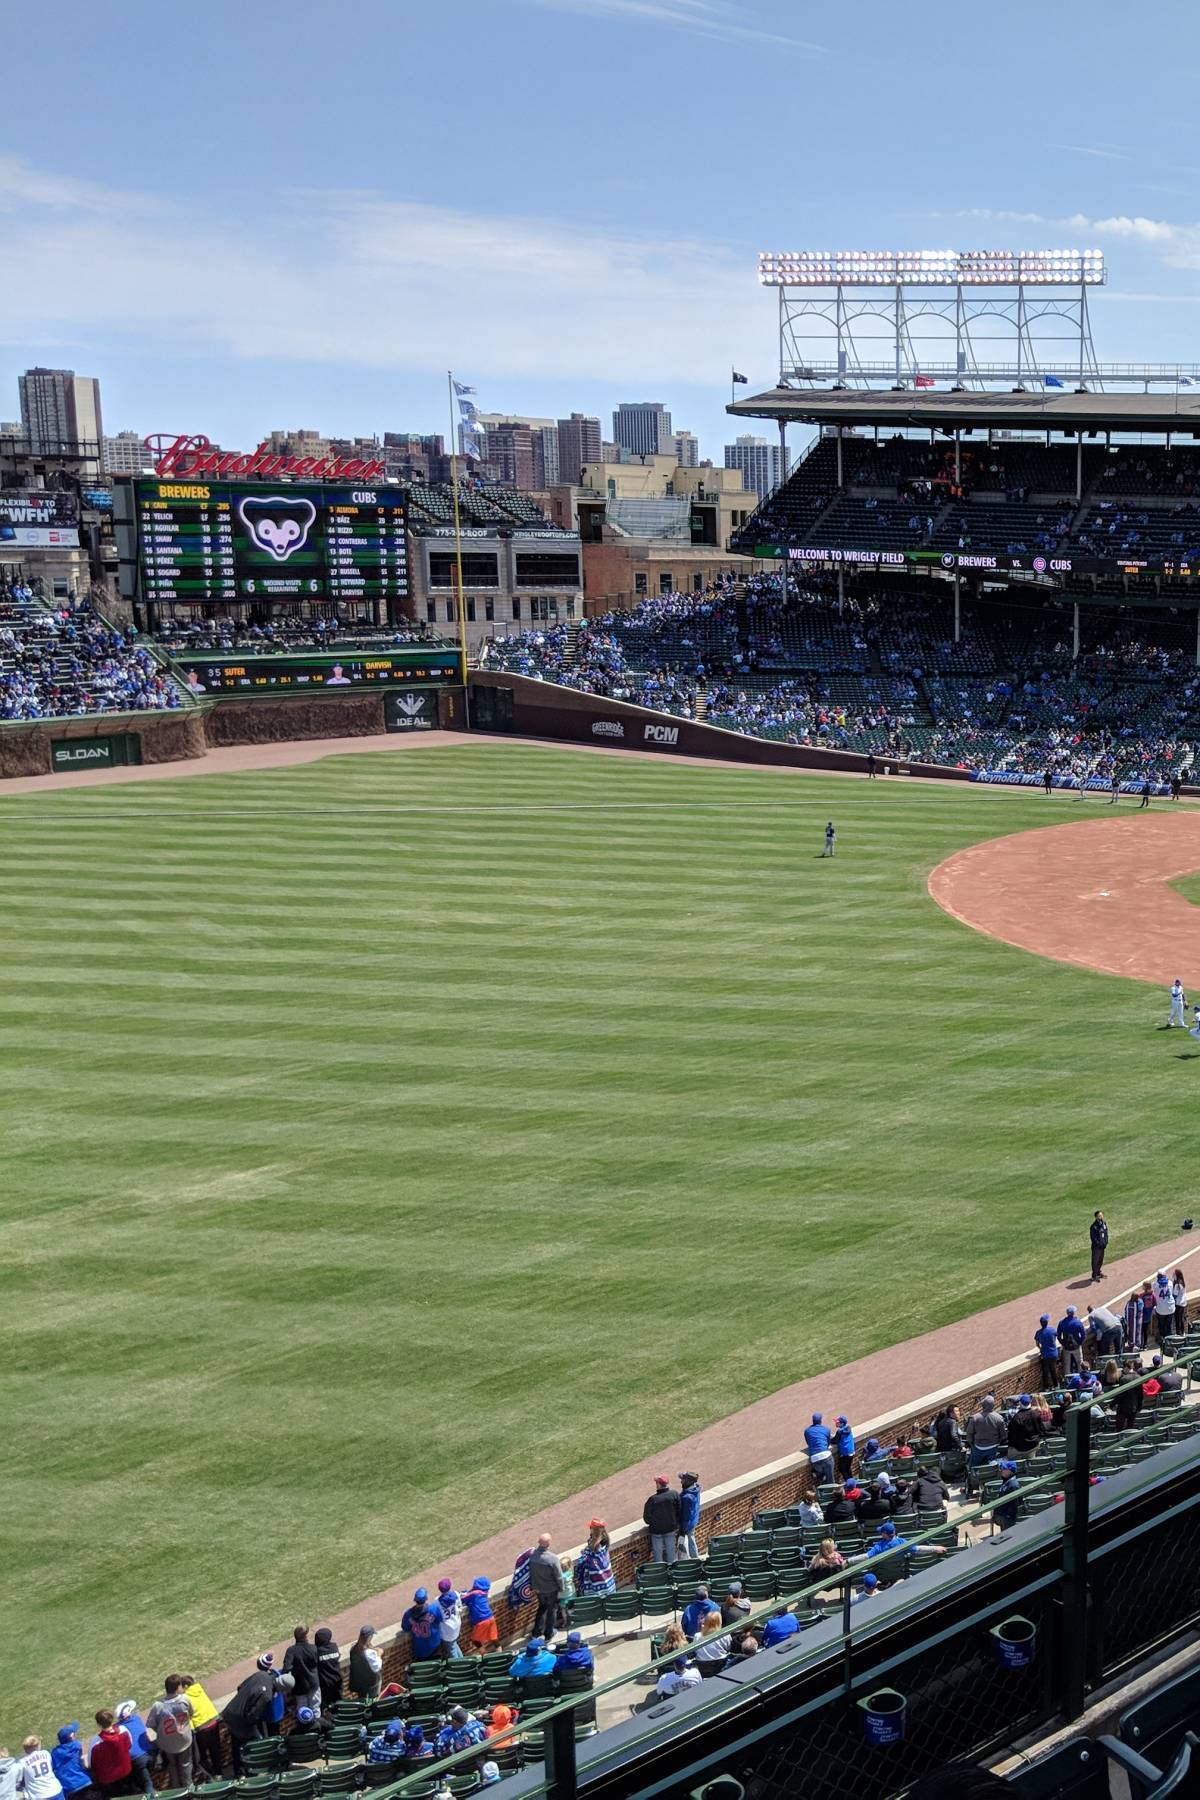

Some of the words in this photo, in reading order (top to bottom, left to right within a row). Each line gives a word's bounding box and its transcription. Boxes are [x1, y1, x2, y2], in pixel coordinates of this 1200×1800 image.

[144, 433, 386, 479] Budweiser
[159, 485, 210, 498] BREWERS
[352, 492, 377, 504] CUBS
[143, 524, 151, 532] 24
[789, 548, 829, 560] WELCOME
[831, 550, 842, 560] TO
[844, 551, 880, 562] WRIGLEY
[881, 552, 904, 563] FIELD
[958, 556, 997, 567] BREWERS
[1049, 560, 1072, 571] CUBS
[247, 580, 255, 593] 6
[310, 579, 318, 592] 6
[365, 661, 392, 670] DARVISH
[208, 668, 221, 677] 35
[224, 668, 245, 676] SUTER
[397, 717, 427, 726] IDEAL
[644, 725, 679, 742] PCM
[56, 747, 109, 761] SLOAN
[976, 771, 1021, 784] Reynolds
[1021, 774, 1046, 786] Wrap
[1159, 1288, 1171, 1300] 44
[411, 1621, 431, 1639] 40
[162, 1712, 190, 1737] 27
[32, 1762, 49, 1778] 18
